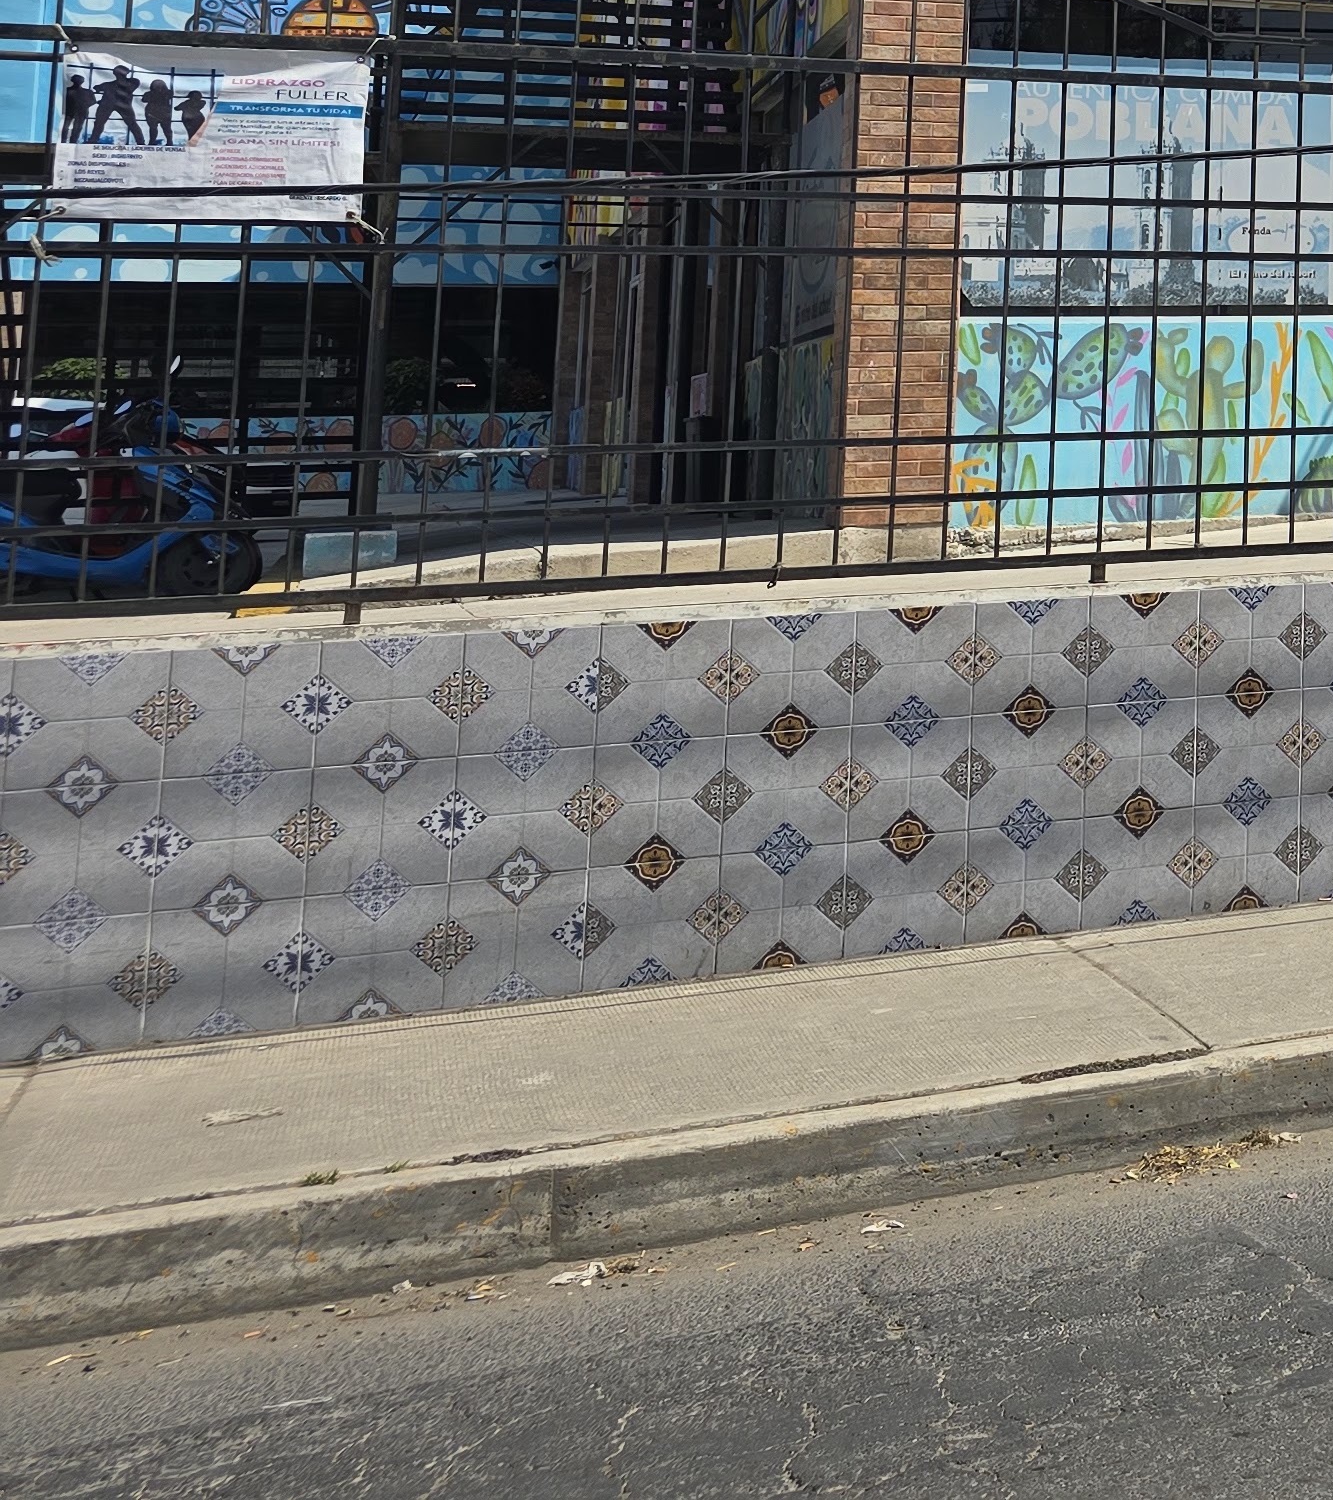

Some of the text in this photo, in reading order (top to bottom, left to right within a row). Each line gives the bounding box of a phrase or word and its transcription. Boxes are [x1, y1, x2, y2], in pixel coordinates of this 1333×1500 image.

[231, 78, 326, 88] LIDERAZGO
[274, 89, 351, 102] FULLER
[229, 104, 352, 115] TRANSFORMA TU VIDA!
[1015, 97, 1296, 146] POBLANA
[222, 138, 266, 146] ¡GANA
